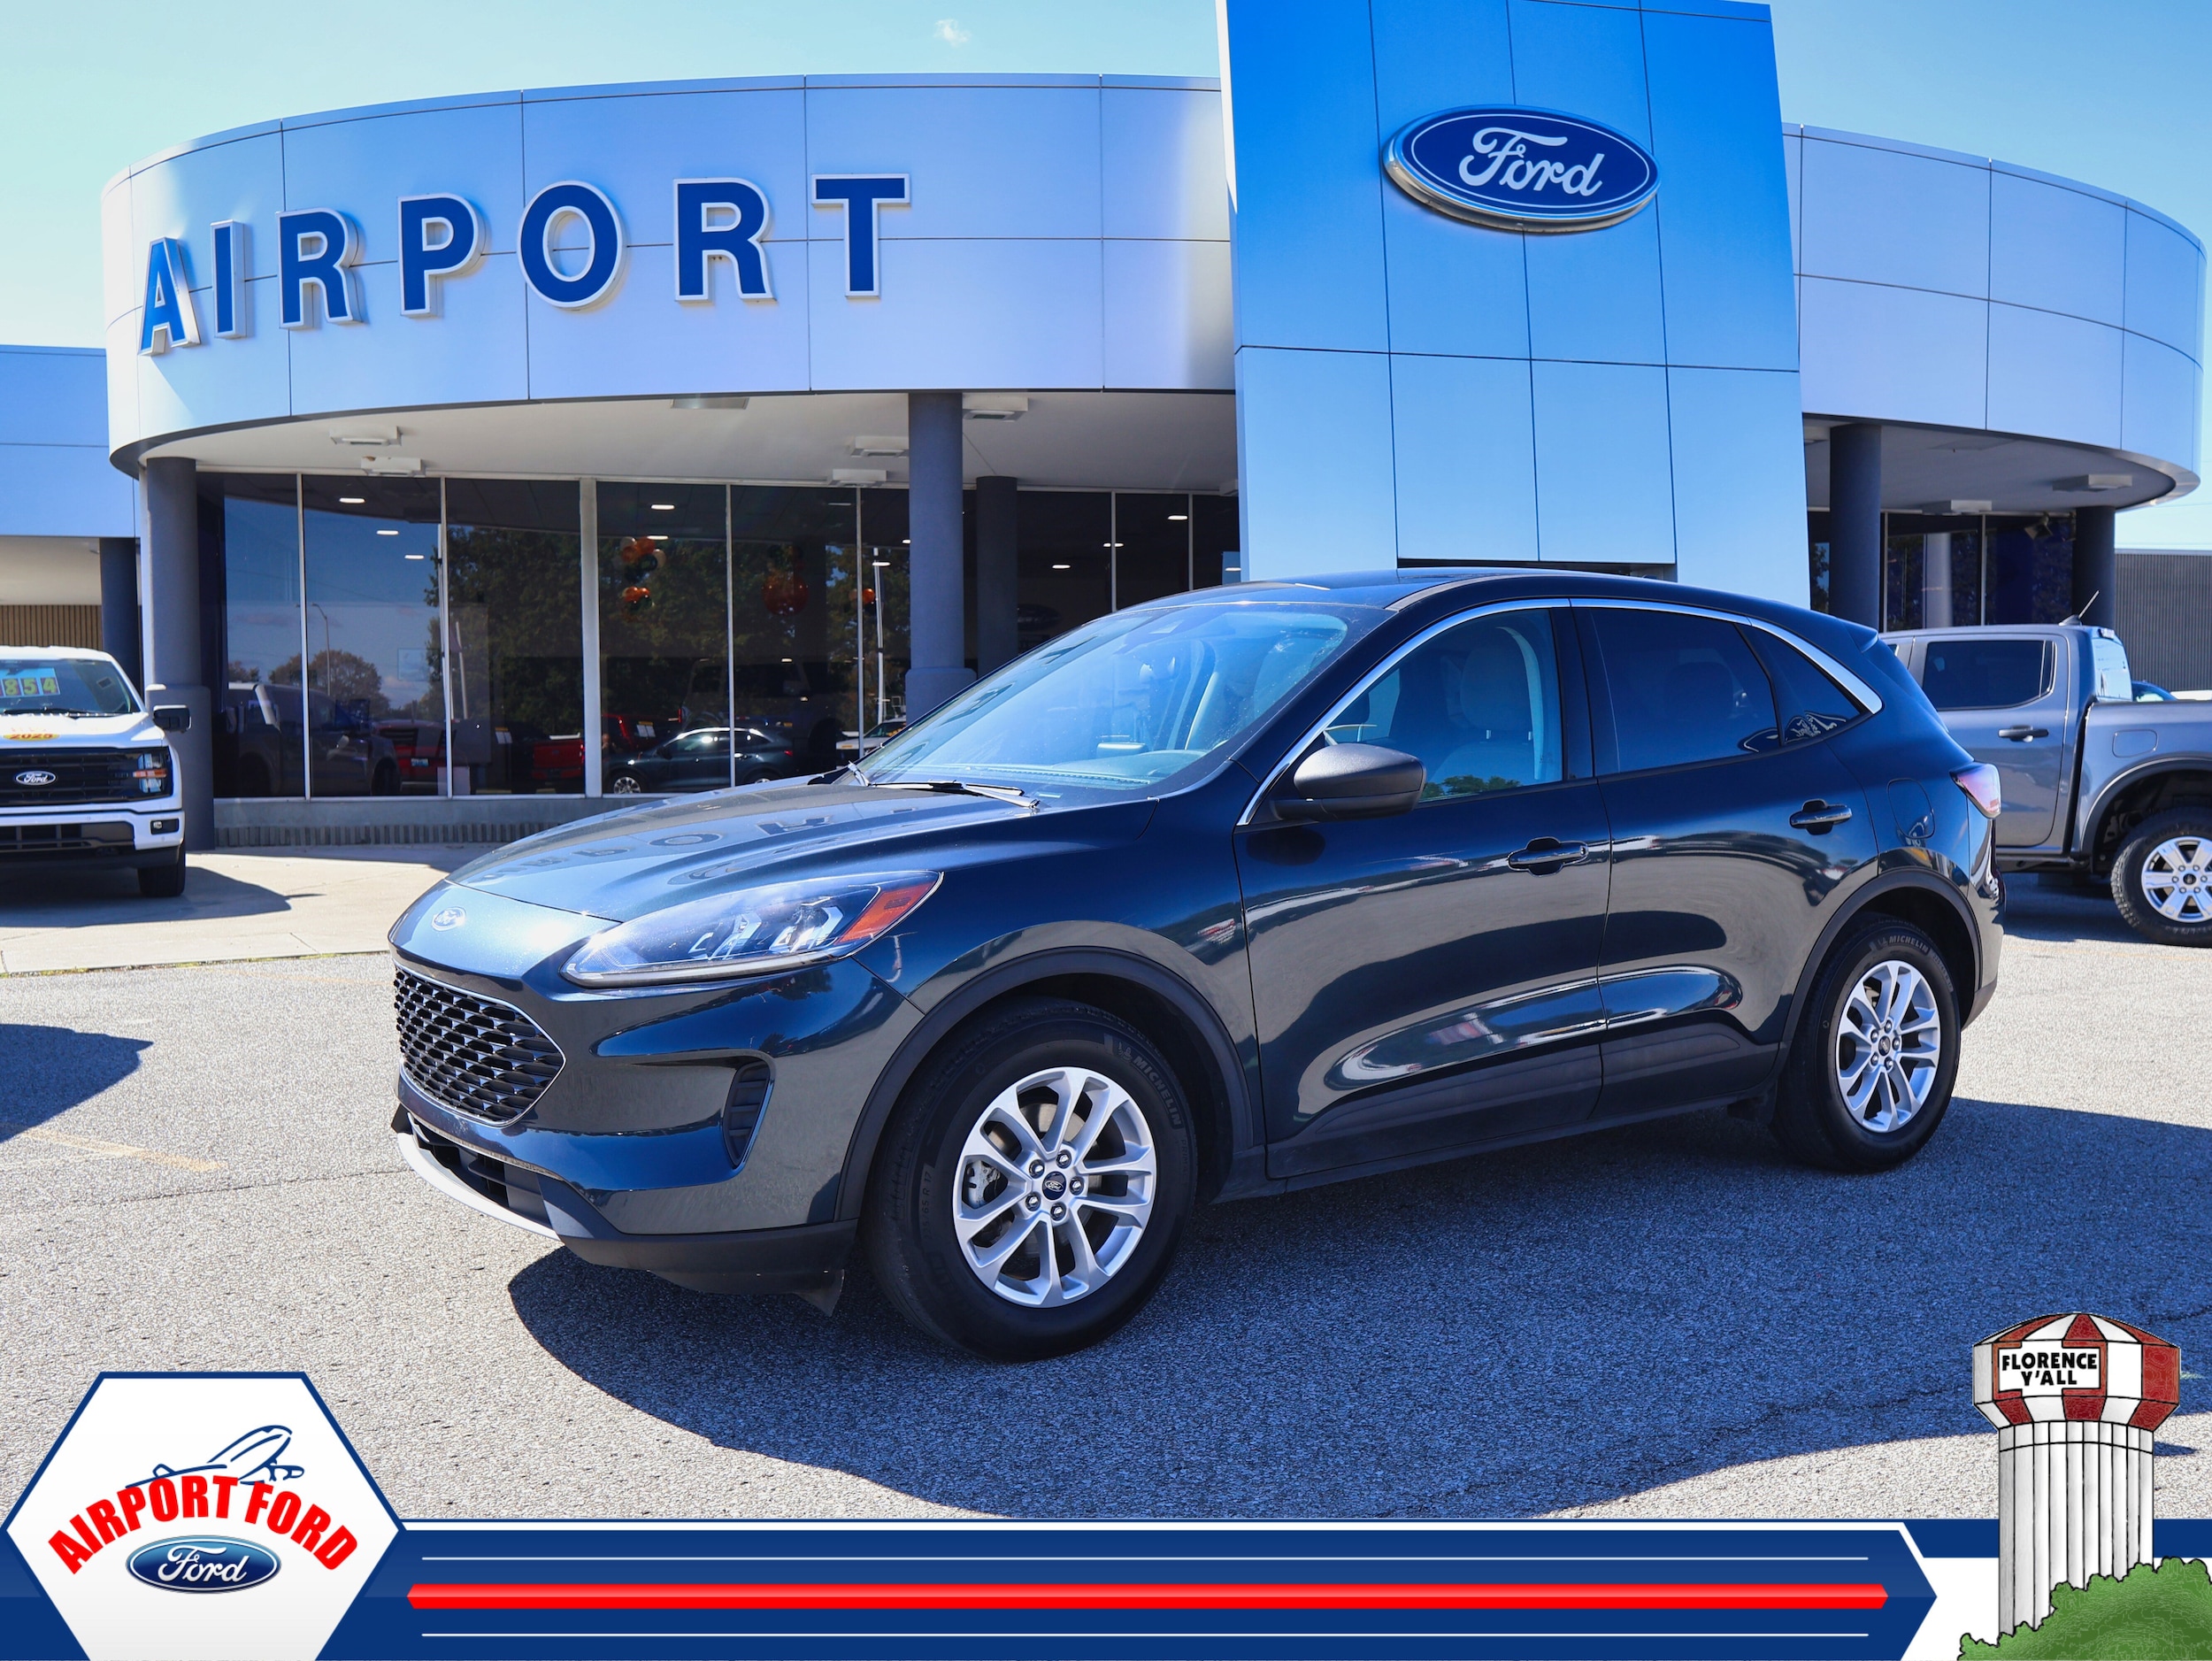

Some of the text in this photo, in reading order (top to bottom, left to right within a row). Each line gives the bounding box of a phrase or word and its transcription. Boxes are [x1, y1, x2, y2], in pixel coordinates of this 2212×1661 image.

[1459, 127, 1606, 196] Ford
[138, 173, 910, 356] AIRPORT
[0, 678, 57, 696] 854
[24, 773, 49, 783] Ford
[1889, 934, 1930, 954] MICHELIN
[1133, 1055, 1182, 1126] MICHELIN
[924, 1171, 932, 1183] 17
